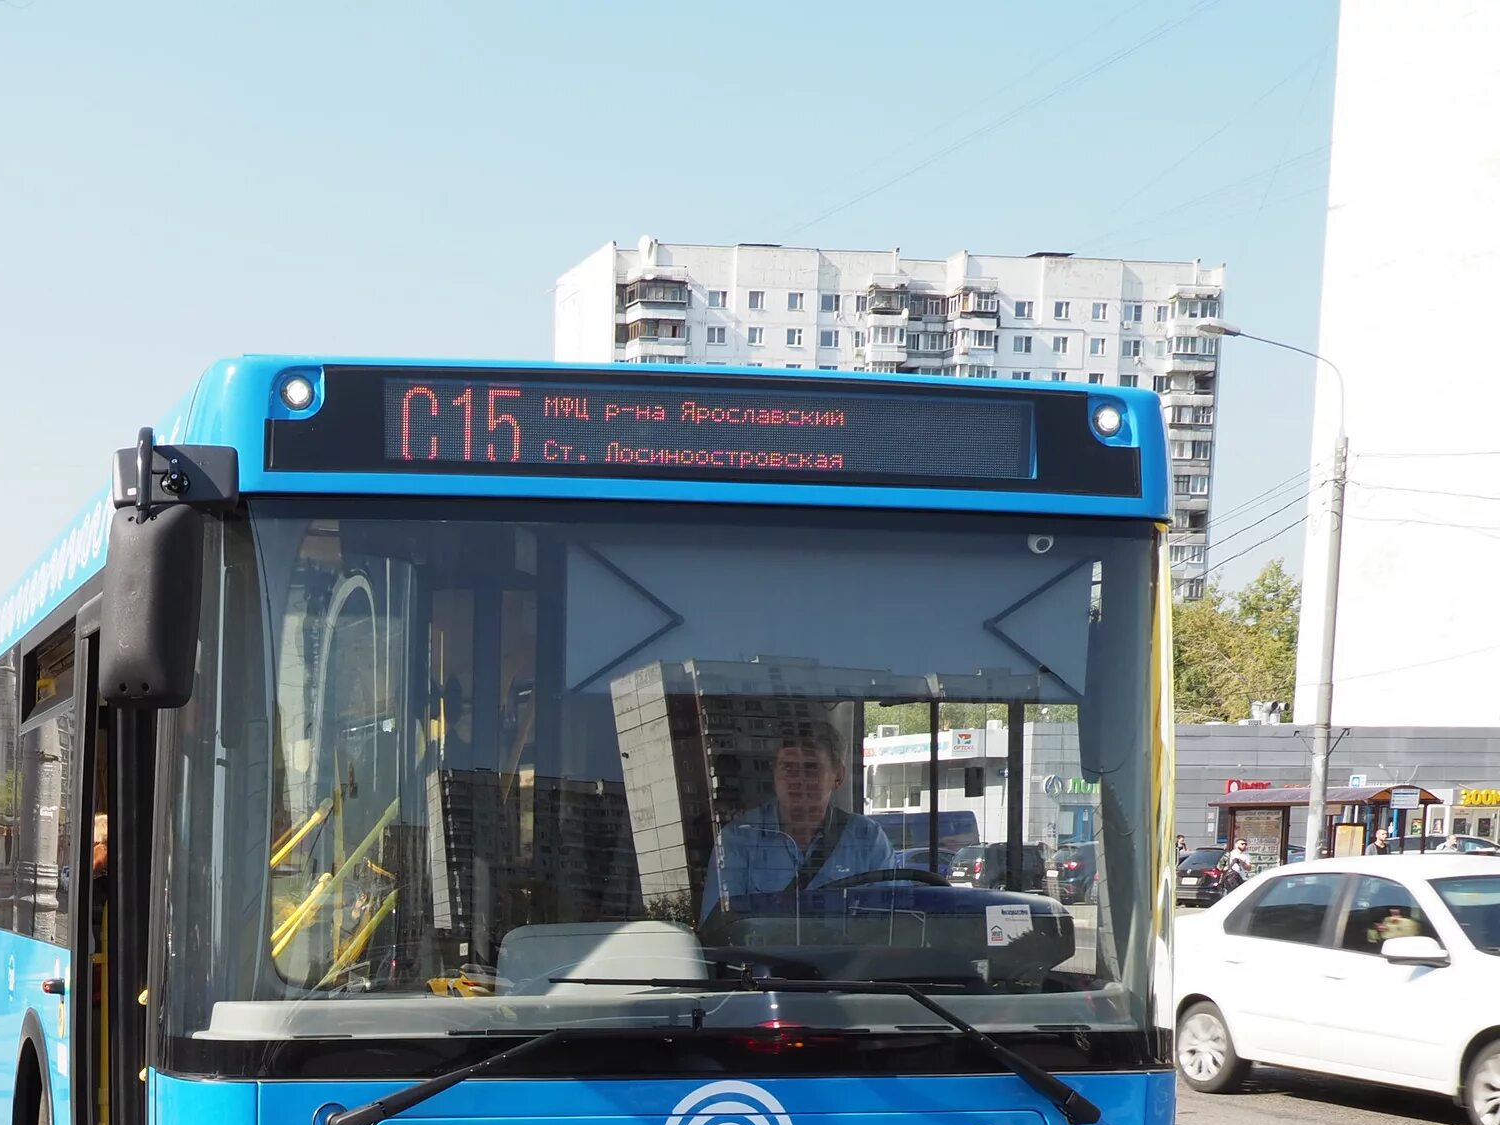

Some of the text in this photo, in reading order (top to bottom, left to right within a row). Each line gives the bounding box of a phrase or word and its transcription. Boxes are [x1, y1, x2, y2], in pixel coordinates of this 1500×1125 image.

[544, 396, 845, 426] МФЦ р-на Ярославский
[543, 439, 844, 469] Ст. Лосиноостровская
